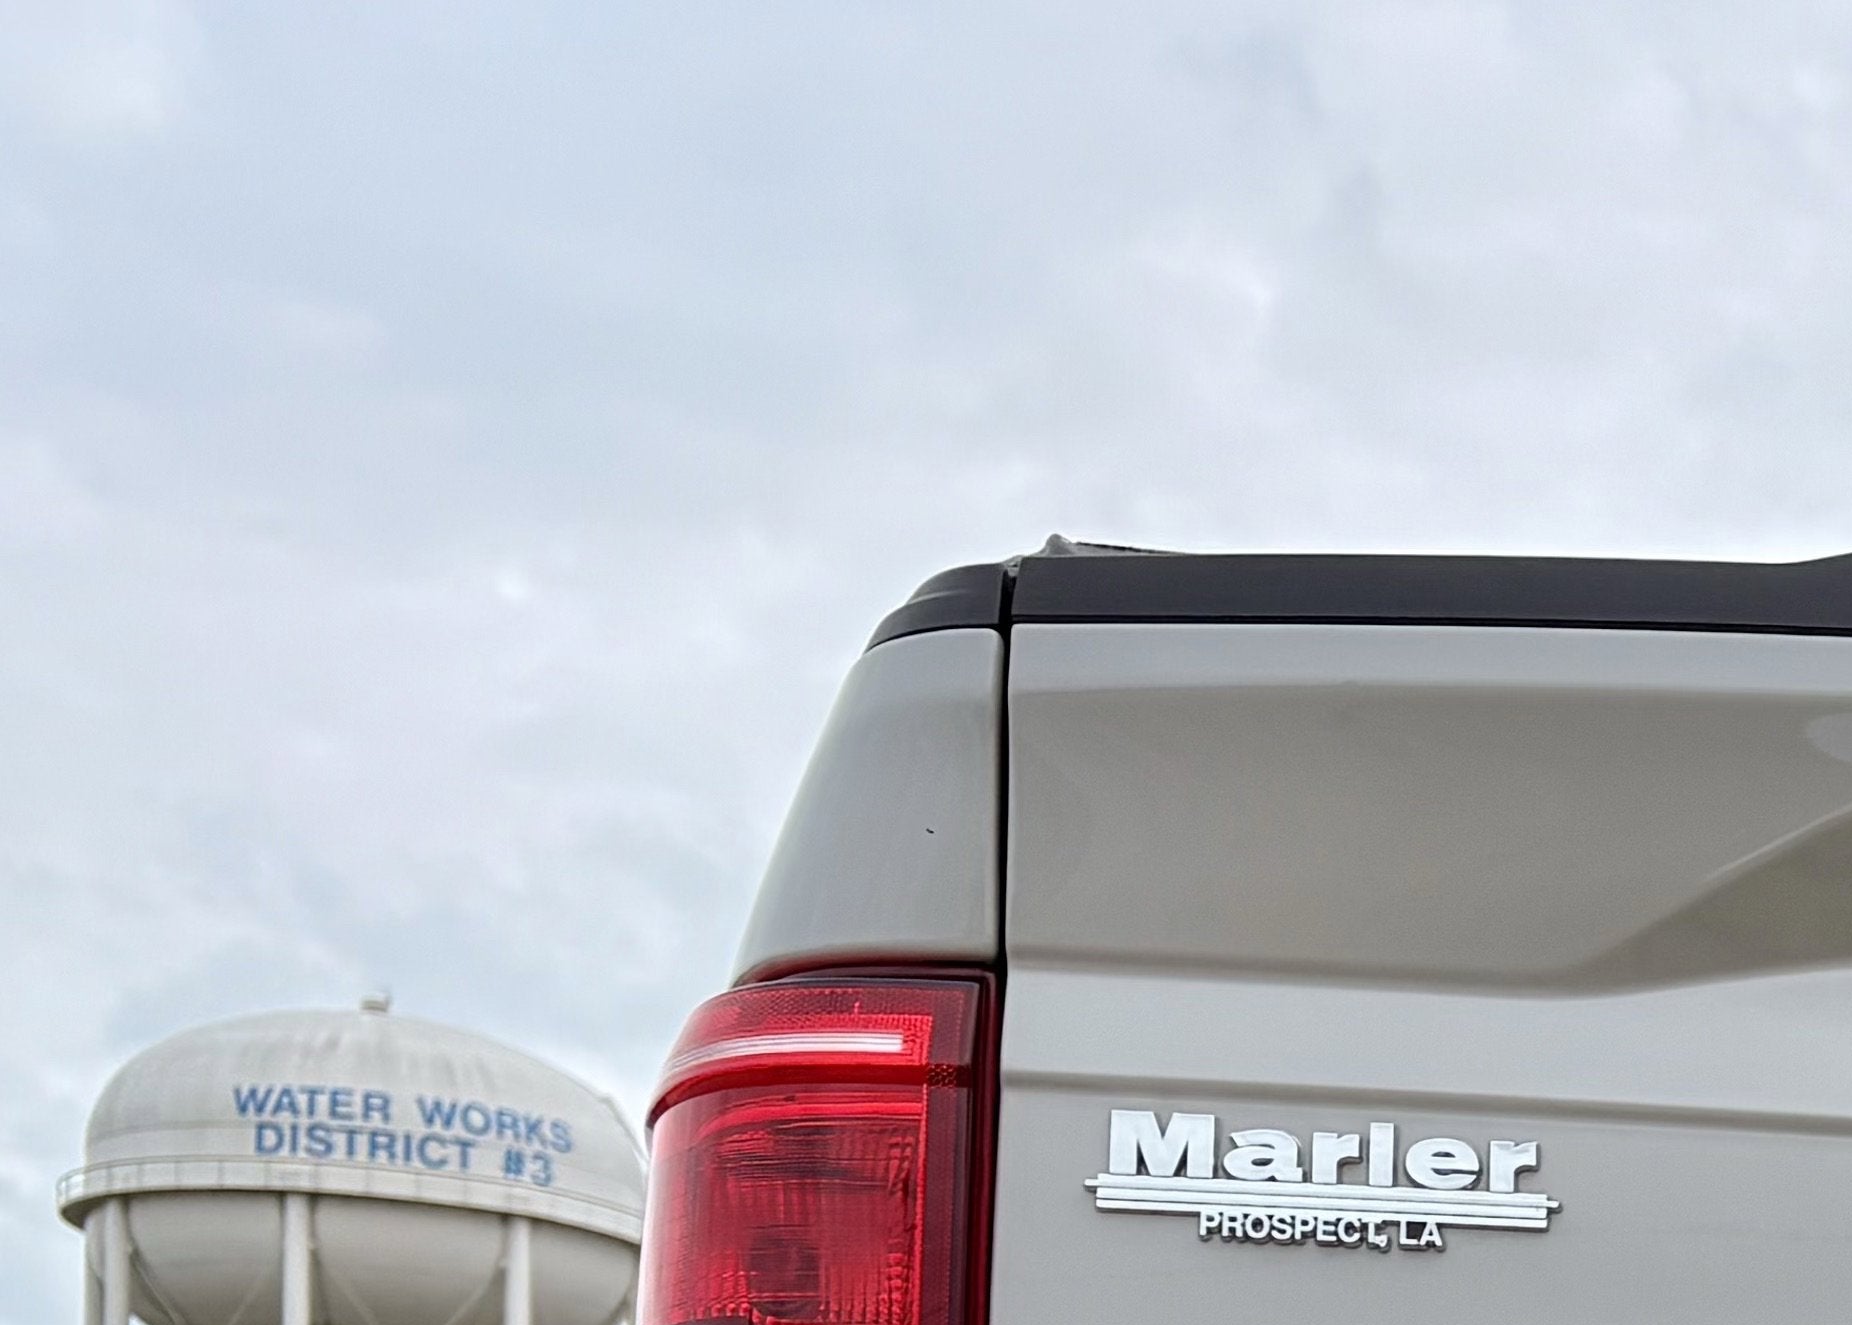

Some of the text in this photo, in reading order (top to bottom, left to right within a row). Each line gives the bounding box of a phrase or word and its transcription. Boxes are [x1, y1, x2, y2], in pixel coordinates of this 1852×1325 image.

[233, 1085, 573, 1154] WATER WORKS
[1109, 1109, 1540, 1194] Marler
[255, 1121, 555, 1187] DISTRICT #3
[1199, 1212, 1445, 1251] PROSPECT, LA
